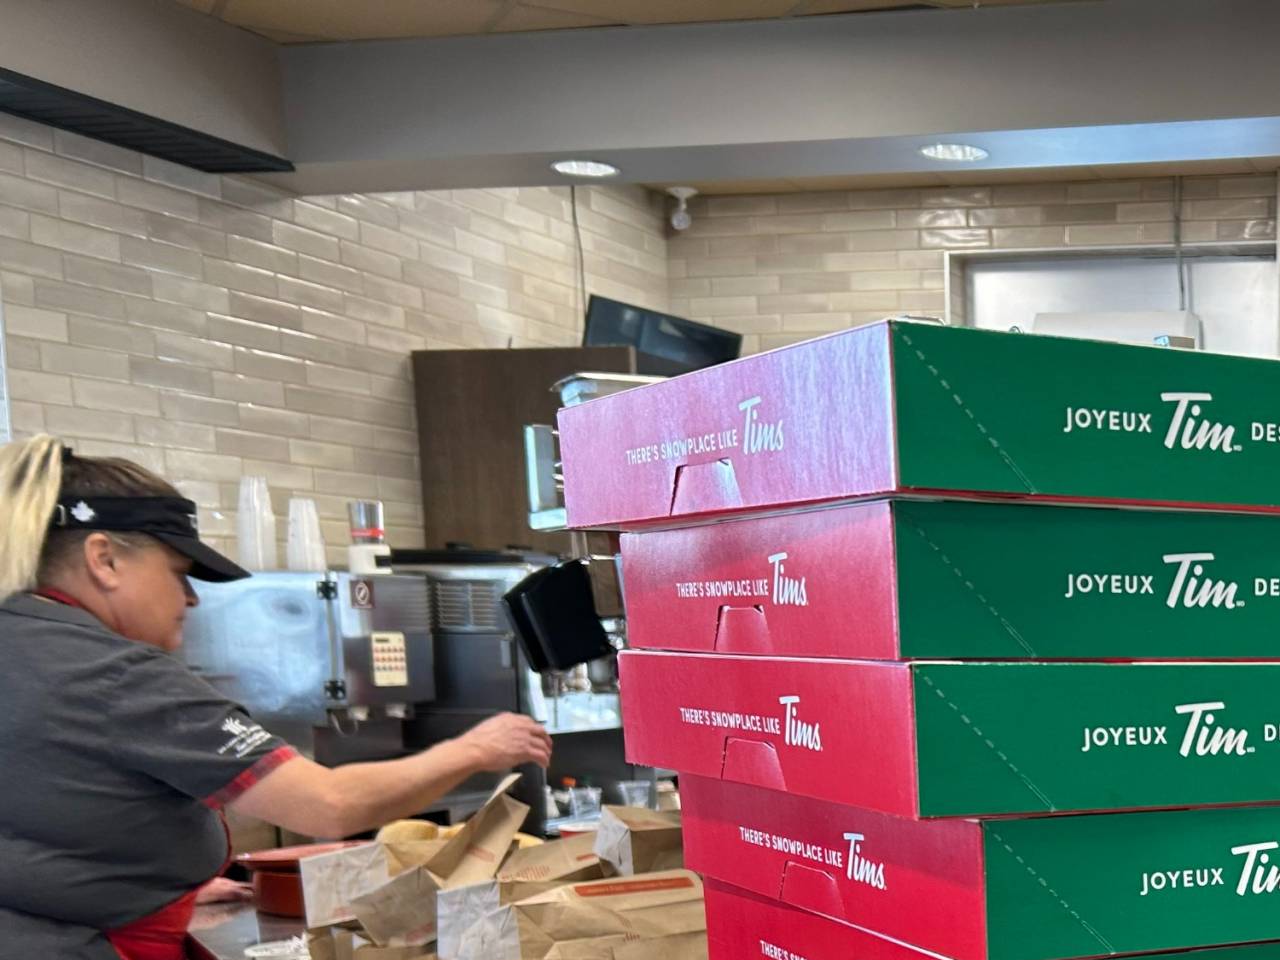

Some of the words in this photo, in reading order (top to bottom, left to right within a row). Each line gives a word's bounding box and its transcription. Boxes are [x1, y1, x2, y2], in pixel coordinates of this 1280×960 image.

[626, 444, 660, 465] THERE'S
[660, 433, 717, 459] SNOWPLACE
[717, 428, 739, 454] LIKE
[738, 396, 784, 456] Tims
[1063, 407, 1152, 433] JOYEUX
[1160, 392, 1236, 453] Tim
[675, 581, 705, 598] THERE'S
[704, 579, 752, 597] SNOWPLACE
[752, 578, 769, 596] LIKE
[767, 551, 809, 607] Tims
[1064, 573, 1154, 598] JOYEUX
[1162, 552, 1238, 610] Tim
[679, 707, 711, 726] THERE'S
[710, 711, 763, 732] SNOWPLACE
[762, 717, 781, 735] LIKE
[778, 695, 823, 752] Tims
[1081, 726, 1168, 752] JOYEUX
[1174, 701, 1249, 758] Tim
[738, 826, 771, 848] THERE'S
[771, 834, 823, 862] SNOWPLACE
[824, 848, 843, 868] LIKE
[843, 832, 887, 891] Tims
[1140, 867, 1225, 896] JOYEUX
